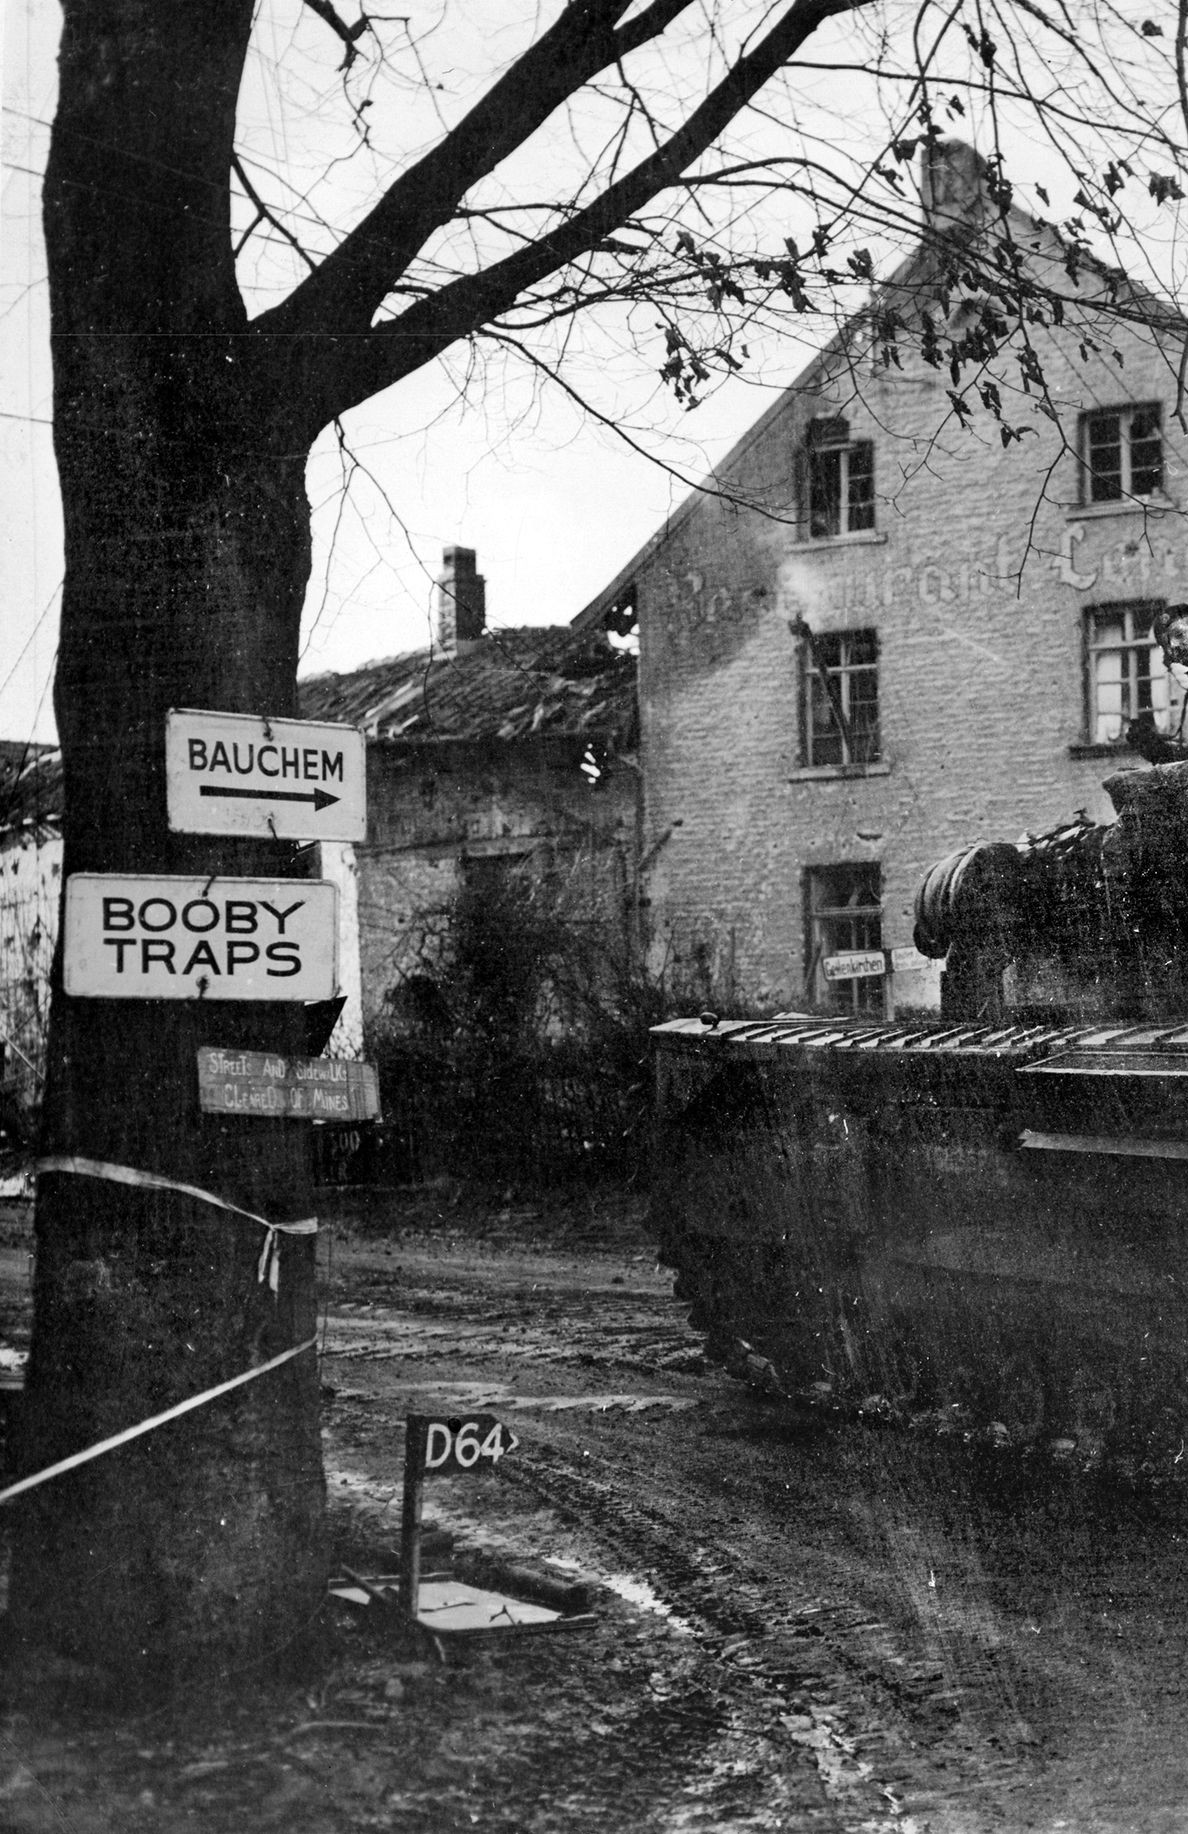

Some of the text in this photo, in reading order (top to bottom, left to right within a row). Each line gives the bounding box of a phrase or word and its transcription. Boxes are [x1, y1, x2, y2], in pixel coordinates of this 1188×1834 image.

[187, 738, 345, 783] BAUCHEM
[102, 896, 306, 935] BOOBY
[102, 937, 302, 977] TRAPS
[263, 1057, 286, 1079] AND
[290, 1087, 304, 1109] OF
[425, 1422, 505, 1469] D64
